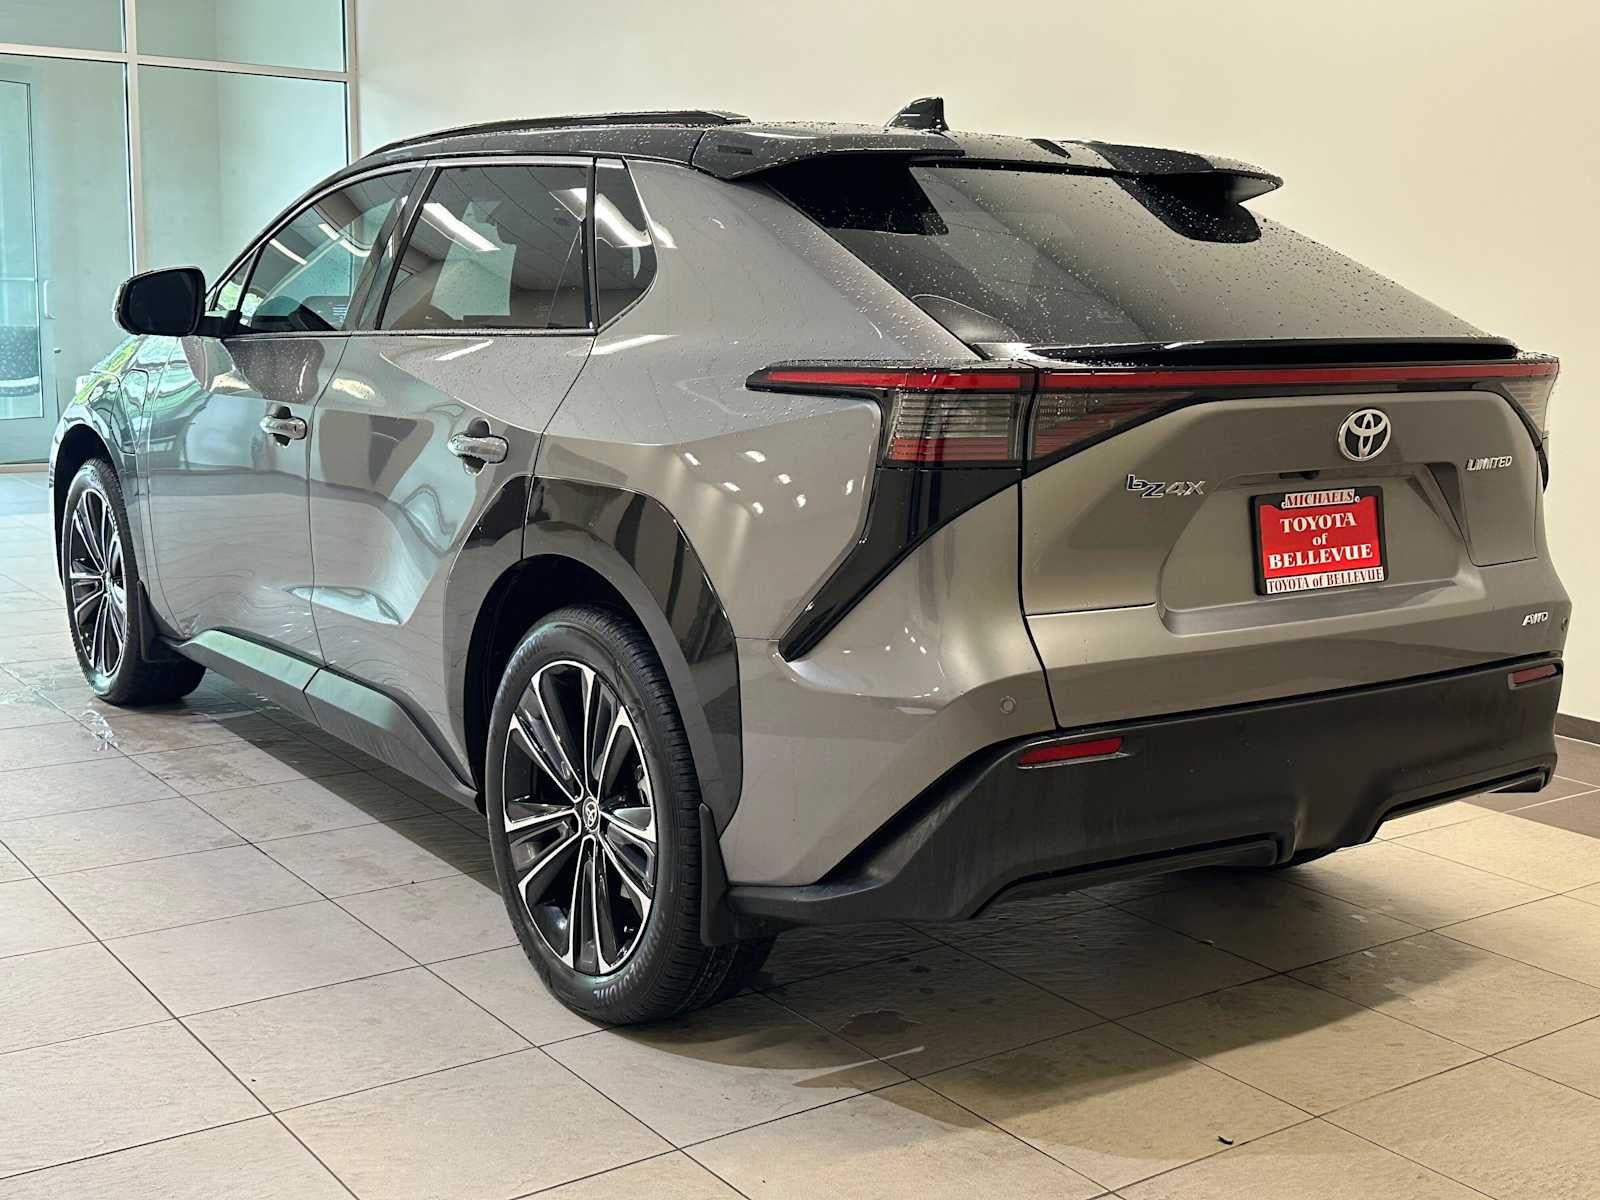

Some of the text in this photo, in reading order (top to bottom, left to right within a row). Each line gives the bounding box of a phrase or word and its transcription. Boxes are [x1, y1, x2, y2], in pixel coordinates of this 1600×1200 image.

[1466, 455, 1513, 471] LIMITED
[1286, 490, 1353, 507] MICHAELS
[1280, 512, 1357, 533] TOYOTA
[1312, 532, 1327, 546] of
[1268, 543, 1373, 570] BELLEVUE
[1267, 567, 1383, 593] TOYOTA of BELLEVUE
